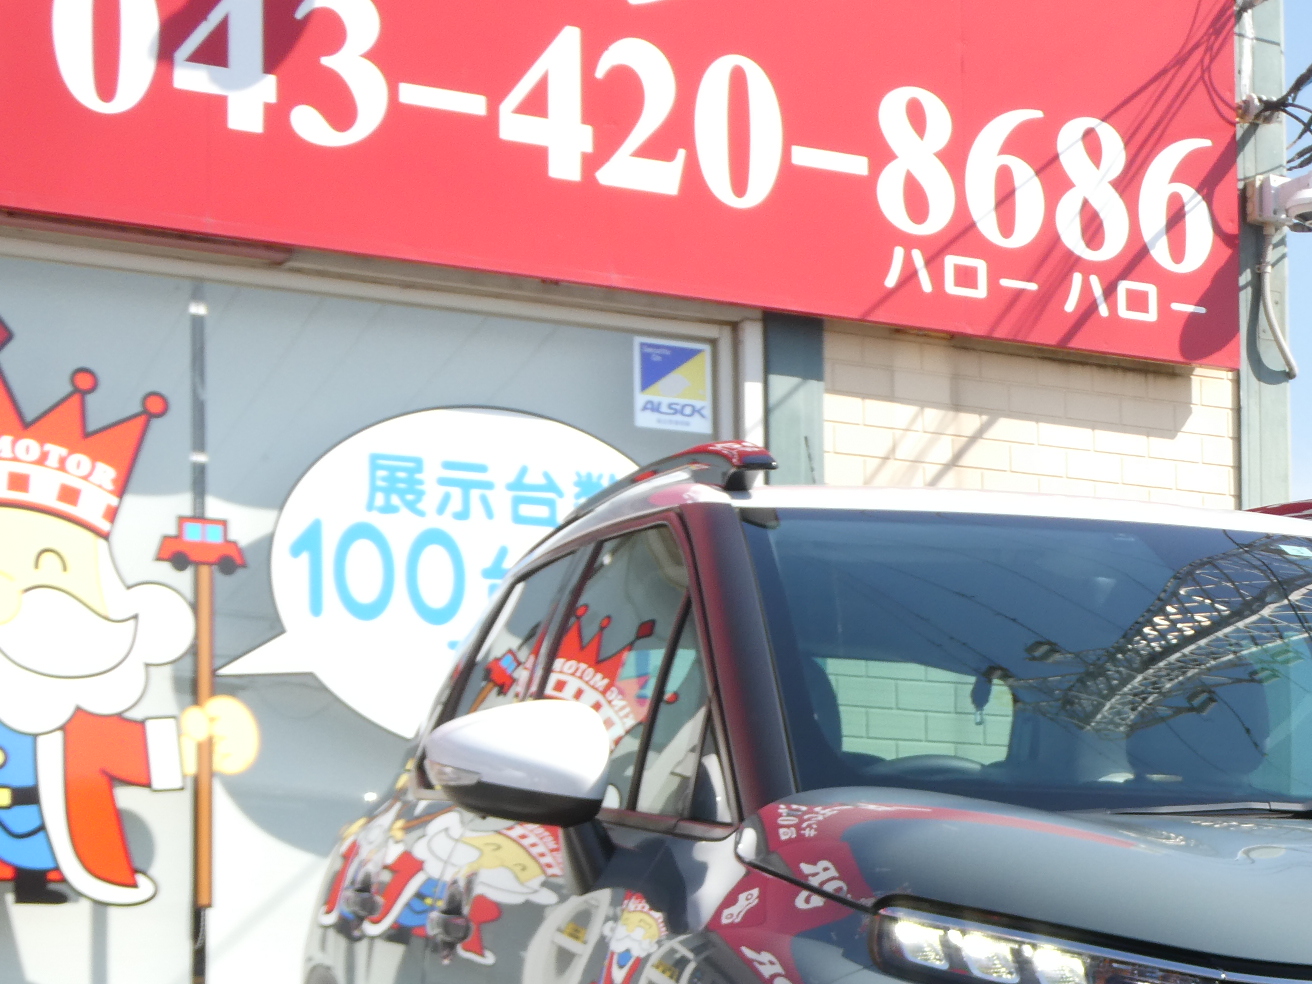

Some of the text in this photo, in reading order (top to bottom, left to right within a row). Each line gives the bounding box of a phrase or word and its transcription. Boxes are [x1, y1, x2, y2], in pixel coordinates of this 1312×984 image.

[884, 246, 1206, 322] ハロー ハロー
[641, 400, 707, 418] ALSOK
